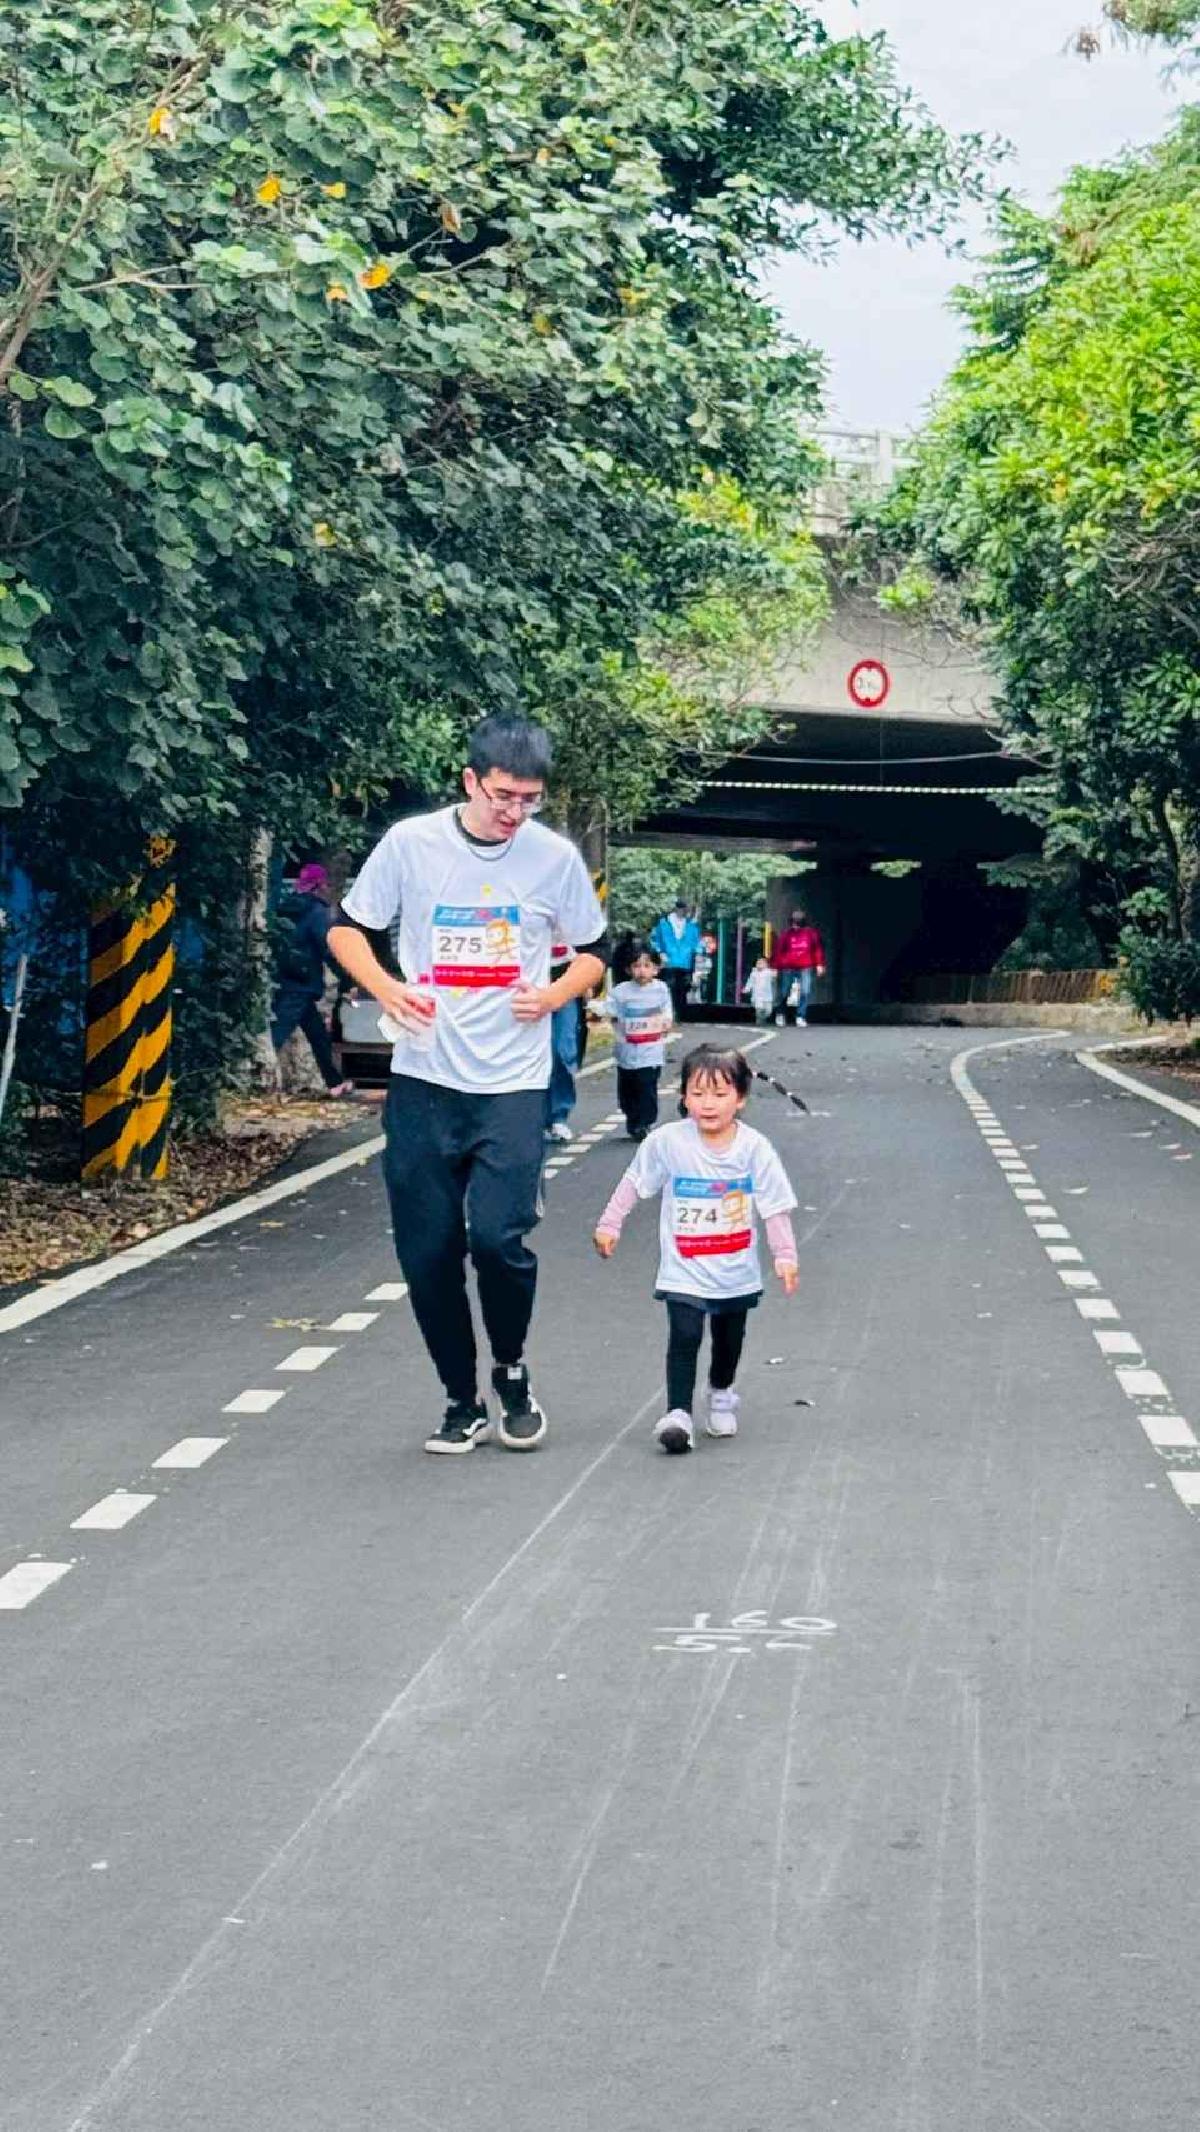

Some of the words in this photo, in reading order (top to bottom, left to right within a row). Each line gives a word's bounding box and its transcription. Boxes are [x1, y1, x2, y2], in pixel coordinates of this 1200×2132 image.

[439, 936, 481, 953] 275
[678, 1207, 718, 1223] 274
[693, 1609, 837, 1630] 160
